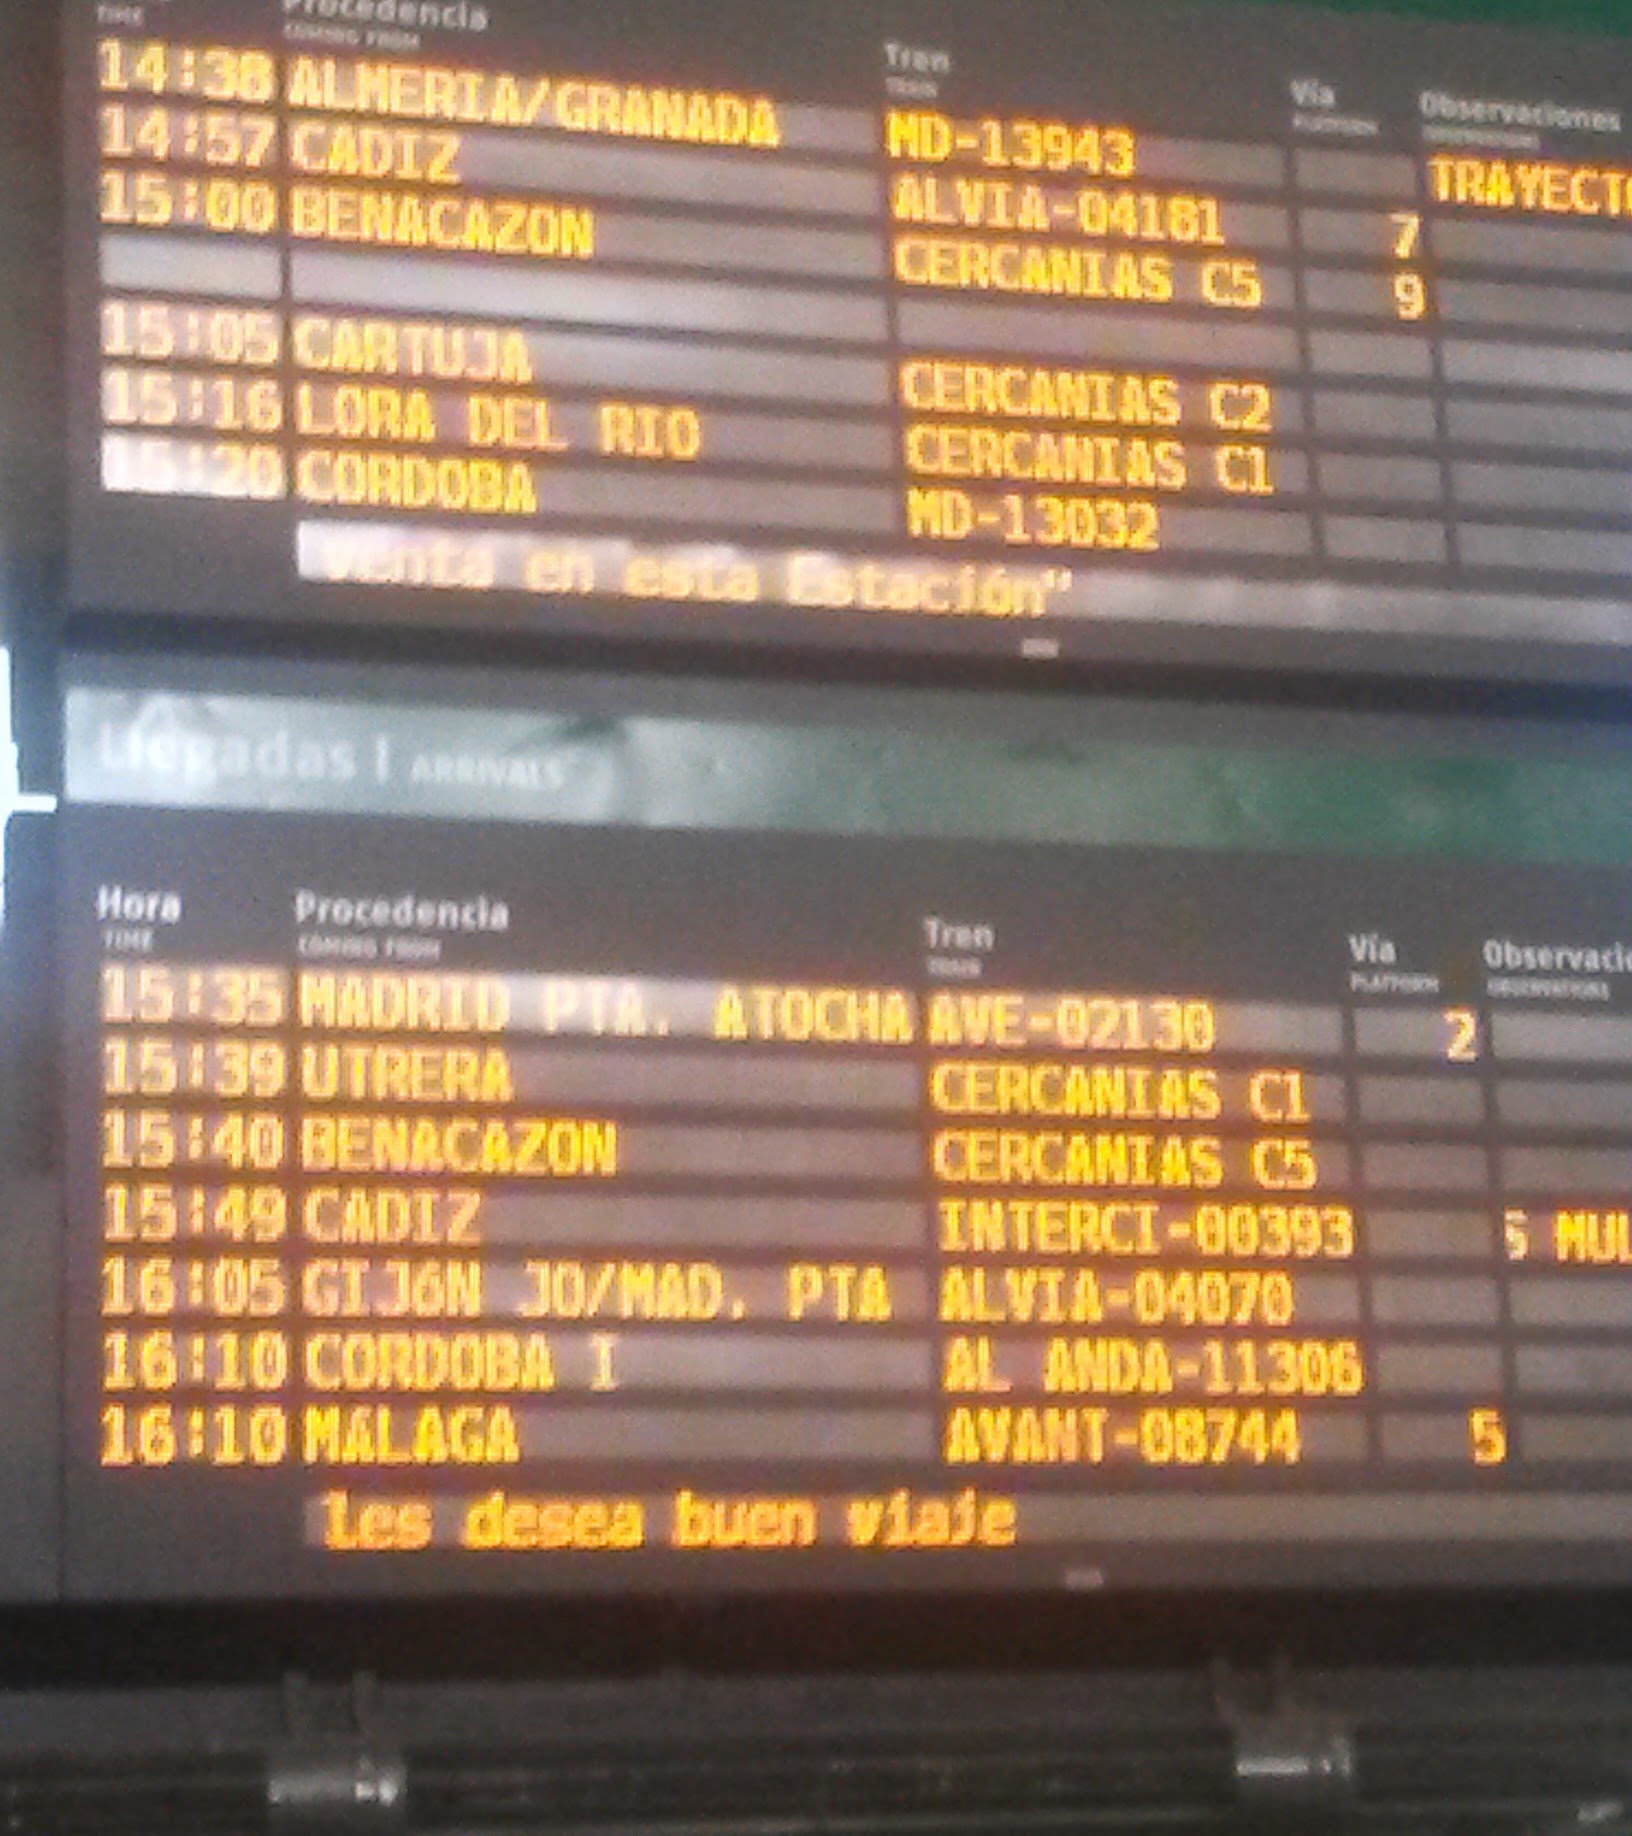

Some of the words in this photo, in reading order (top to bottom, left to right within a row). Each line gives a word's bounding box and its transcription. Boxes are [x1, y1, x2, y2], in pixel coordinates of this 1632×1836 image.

[287, 54, 782, 149] ALMERIA/GRANADA
[886, 110, 1136, 176] MD-13943
[1420, 89, 1622, 133] Observaciones
[101, 105, 277, 169] 14:57
[292, 121, 462, 184] CADIZ
[895, 172, 1226, 247] ALVIA-04181
[1389, 211, 1421, 260] 7
[101, 168, 278, 234] 15:00
[291, 185, 595, 260] BENACAZON
[895, 235, 1173, 303] CERCANIAS
[1201, 259, 1263, 309] C5
[1392, 271, 1426, 321] 9
[101, 301, 280, 364] 15:05
[294, 317, 534, 384] CARTUJA
[900, 357, 1182, 428] CERCANIAS
[1208, 380, 1274, 434] C2
[101, 368, 282, 431] 15:16
[297, 382, 436, 442] LORA
[468, 390, 569, 452] DEL
[599, 400, 702, 461] RIO
[904, 420, 1188, 493] CERCANIAS
[1214, 442, 1276, 497] C1
[101, 432, 284, 499] 15:20
[297, 449, 538, 513] CORDOBA
[905, 485, 1162, 554] MD-13032
[524, 550, 595, 595] en
[625, 551, 760, 602] esta
[100, 719, 358, 789] Llegadas
[410, 752, 565, 790] ARRIVALS
[96, 883, 182, 926] Hora
[294, 887, 511, 933] Procedencia
[922, 914, 996, 950] Tren
[102, 963, 286, 1025] 15:35
[300, 969, 512, 1034] MADRID
[712, 986, 915, 1043] ATOCHA
[928, 993, 1216, 1053] AVE-02130
[1444, 1006, 1477, 1063] 2
[102, 1036, 286, 1097] 15:39
[301, 1044, 514, 1103] UTRERA
[929, 1059, 1222, 1123] CERCANIAS
[1248, 1069, 1311, 1125] C1
[101, 1109, 285, 1169] 15:40
[301, 1115, 619, 1178] BENACAZON
[931, 1128, 1223, 1190] CERCANIAS
[1253, 1138, 1317, 1191] C5
[103, 1183, 288, 1244] 15:49
[303, 1188, 482, 1246] CADIZ
[939, 1203, 1355, 1259] INTERCI-00393
[100, 1258, 285, 1318] 16:05
[787, 1264, 892, 1323] PTA
[939, 1264, 1295, 1327] ALVIA-04070
[101, 1332, 288, 1392] 16:10
[304, 1331, 556, 1392] CORDOBA
[943, 1334, 1013, 1395] AL
[1043, 1335, 1364, 1397] ANDA-11306
[100, 1403, 289, 1465] 16:10
[945, 1406, 1300, 1465] AVANT-08744
[1468, 1408, 1507, 1464] 5
[324, 1489, 432, 1550] les
[463, 1490, 644, 1551] desea
[674, 1490, 818, 1550] buen
[844, 1488, 1017, 1548] viaje
